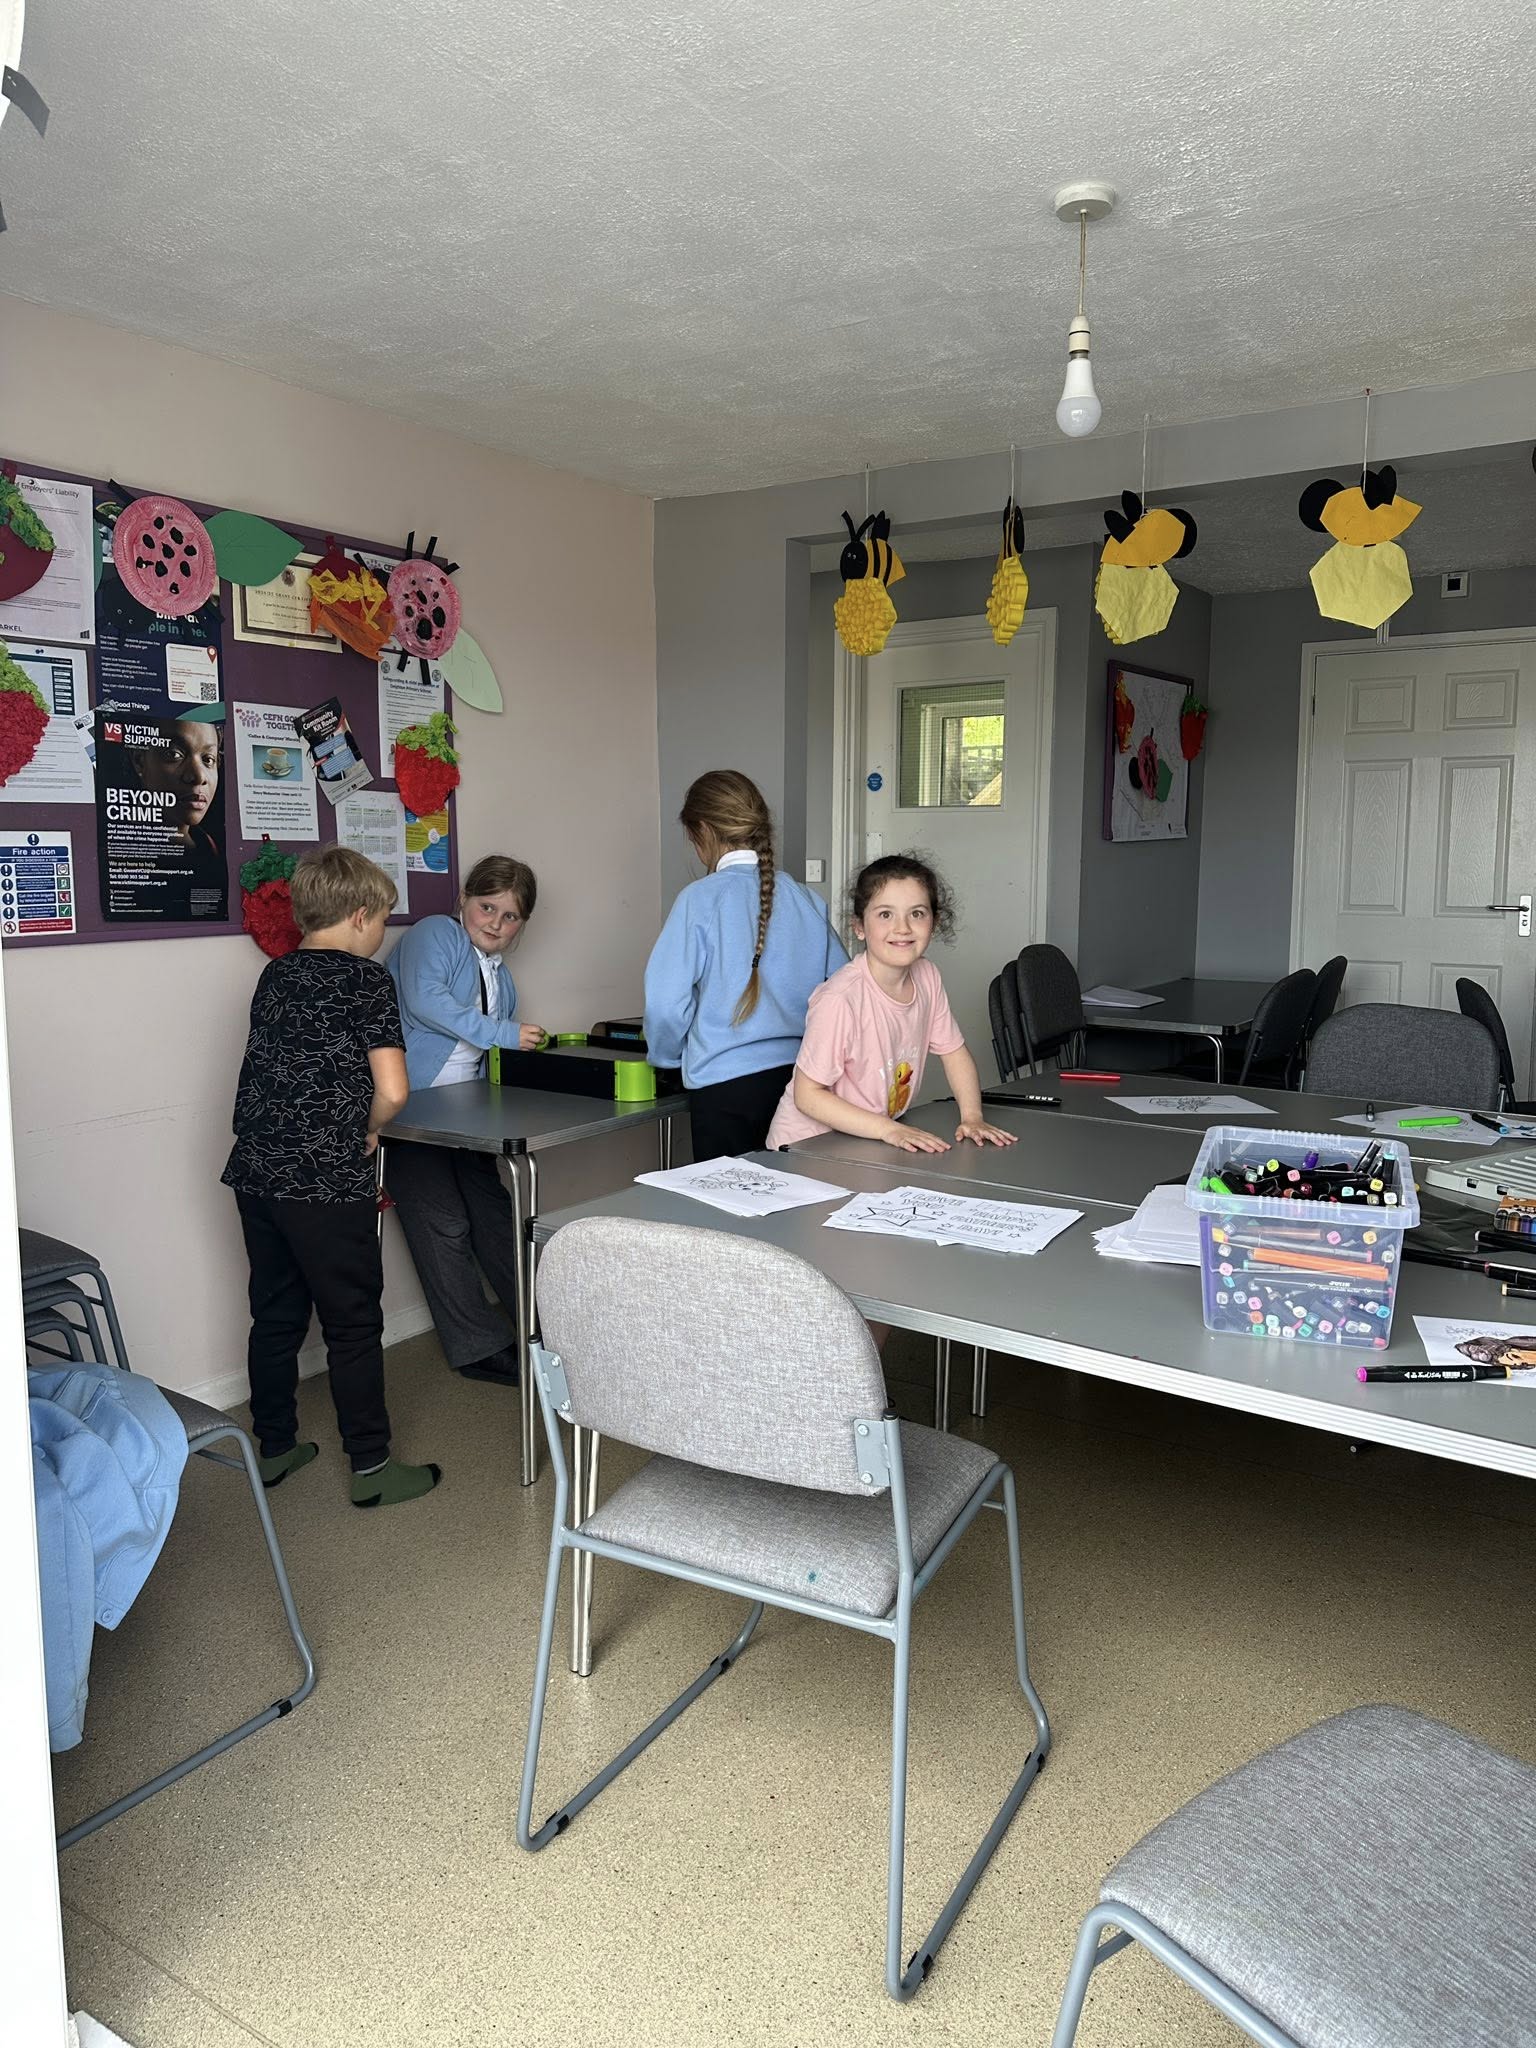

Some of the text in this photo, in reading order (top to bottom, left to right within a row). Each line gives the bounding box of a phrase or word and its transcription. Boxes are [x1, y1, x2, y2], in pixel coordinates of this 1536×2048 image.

[55, 488, 79, 499] Liability
[0, 623, 22, 632] ARKEL
[168, 623, 179, 634] in
[131, 702, 150, 711] Things
[262, 713, 283, 722] CEFN
[303, 710, 334, 730] Community
[105, 722, 122, 734] VS
[124, 724, 160, 737] VICTIM
[313, 724, 322, 733] Kit
[321, 716, 338, 728] Room
[124, 734, 172, 748] SUPPORT
[106, 788, 177, 807] BEYOND
[106, 805, 163, 823] CRIME
